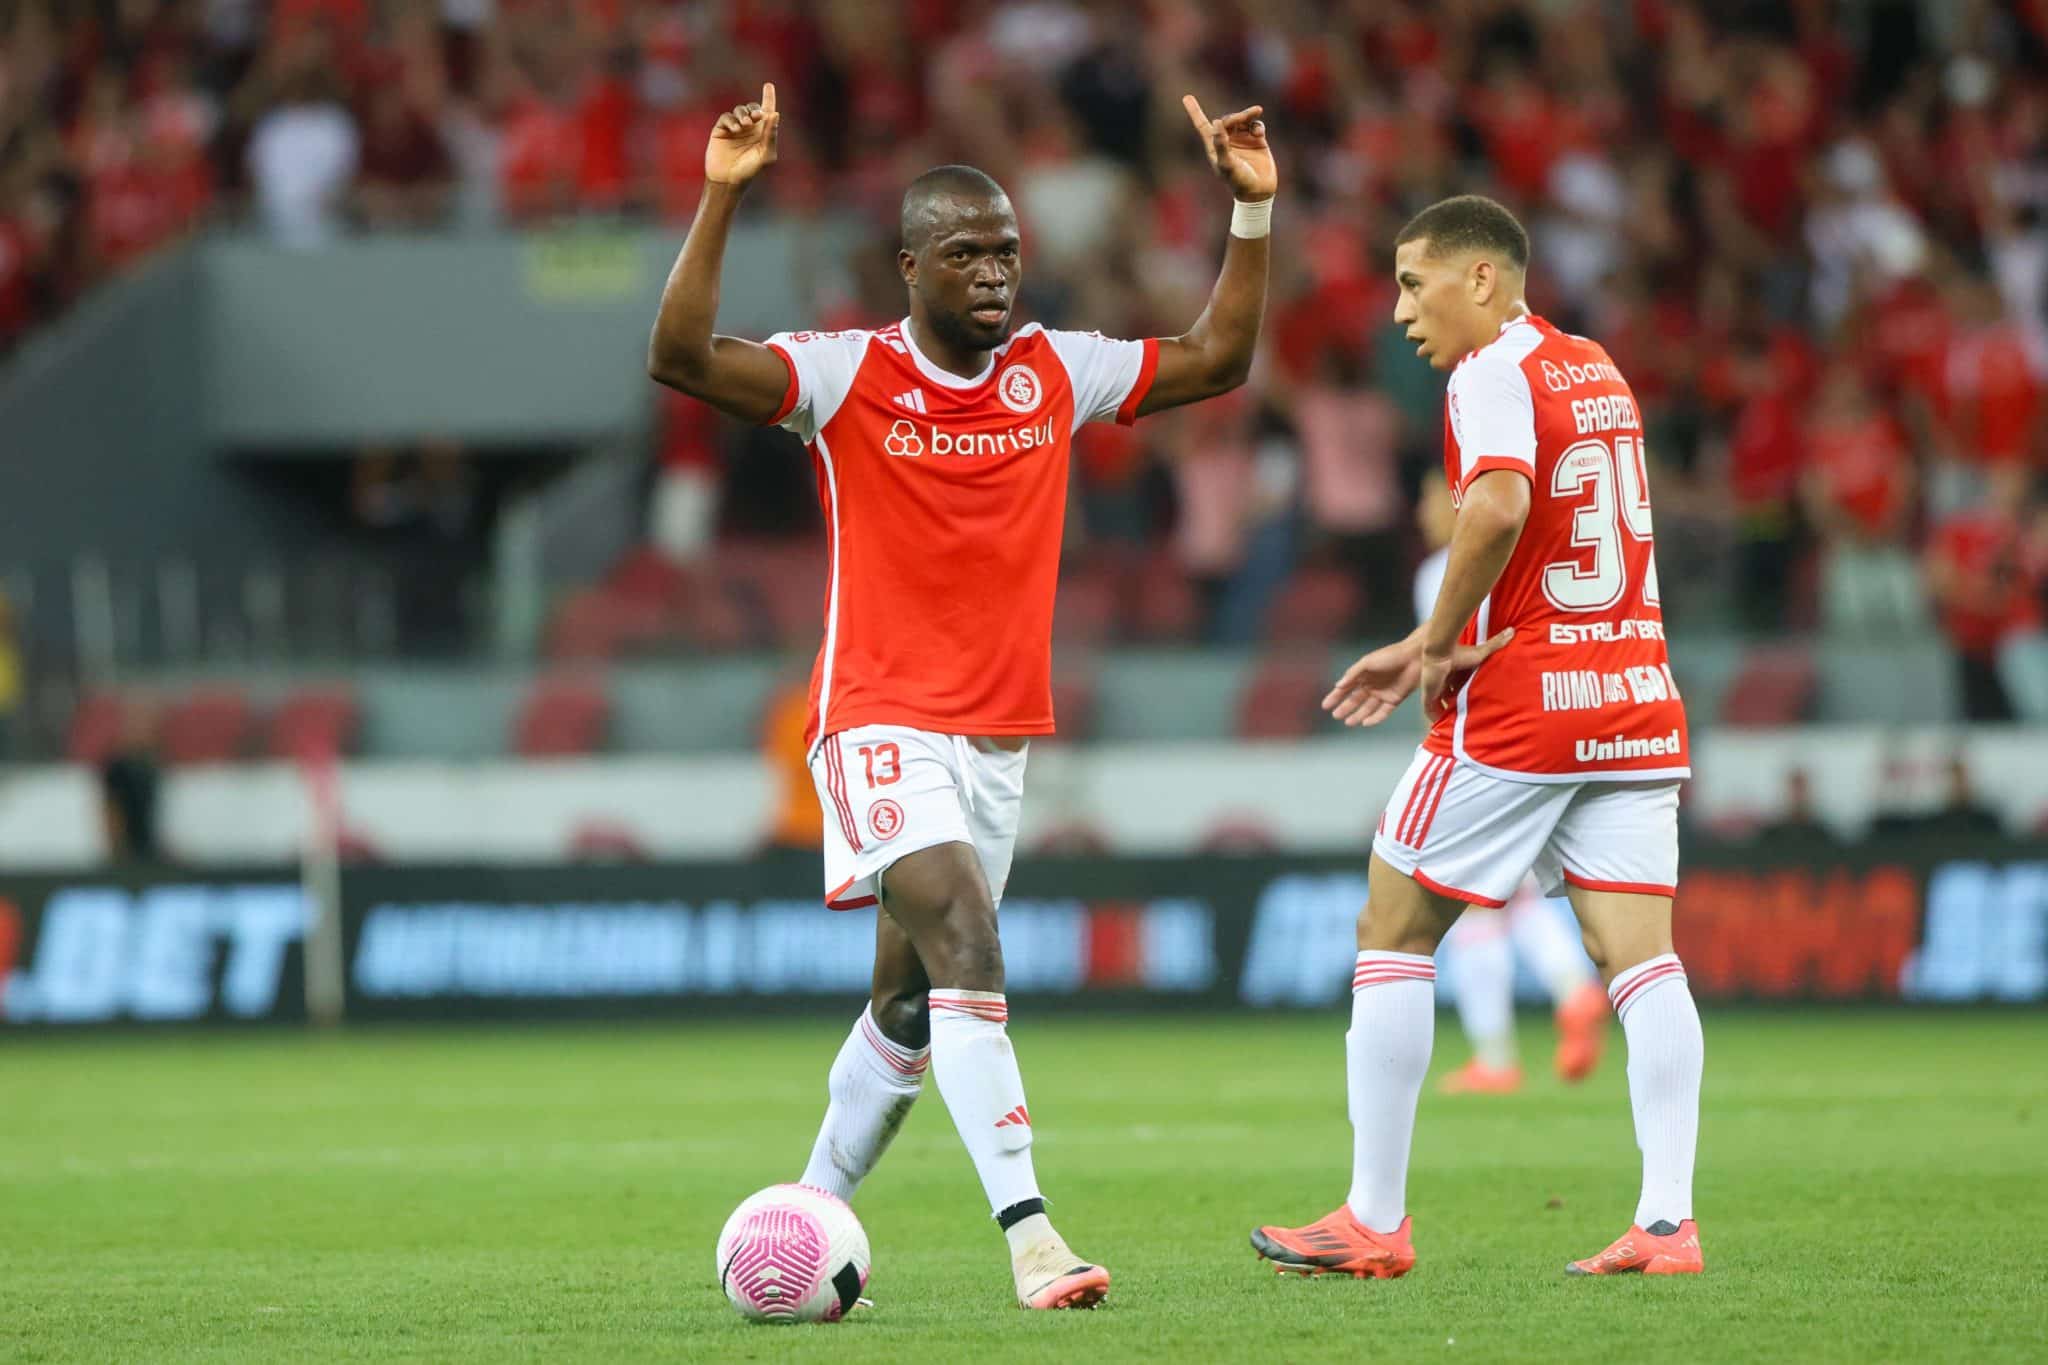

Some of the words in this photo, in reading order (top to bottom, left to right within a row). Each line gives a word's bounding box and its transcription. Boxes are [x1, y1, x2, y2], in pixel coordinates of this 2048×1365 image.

[931, 415, 1054, 455] banrisul
[1541, 436, 1662, 613] 34
[1541, 670, 1602, 711] RUMO
[1624, 665, 1668, 704] 150
[858, 742, 901, 789] 13
[1575, 729, 1681, 762] Unimed
